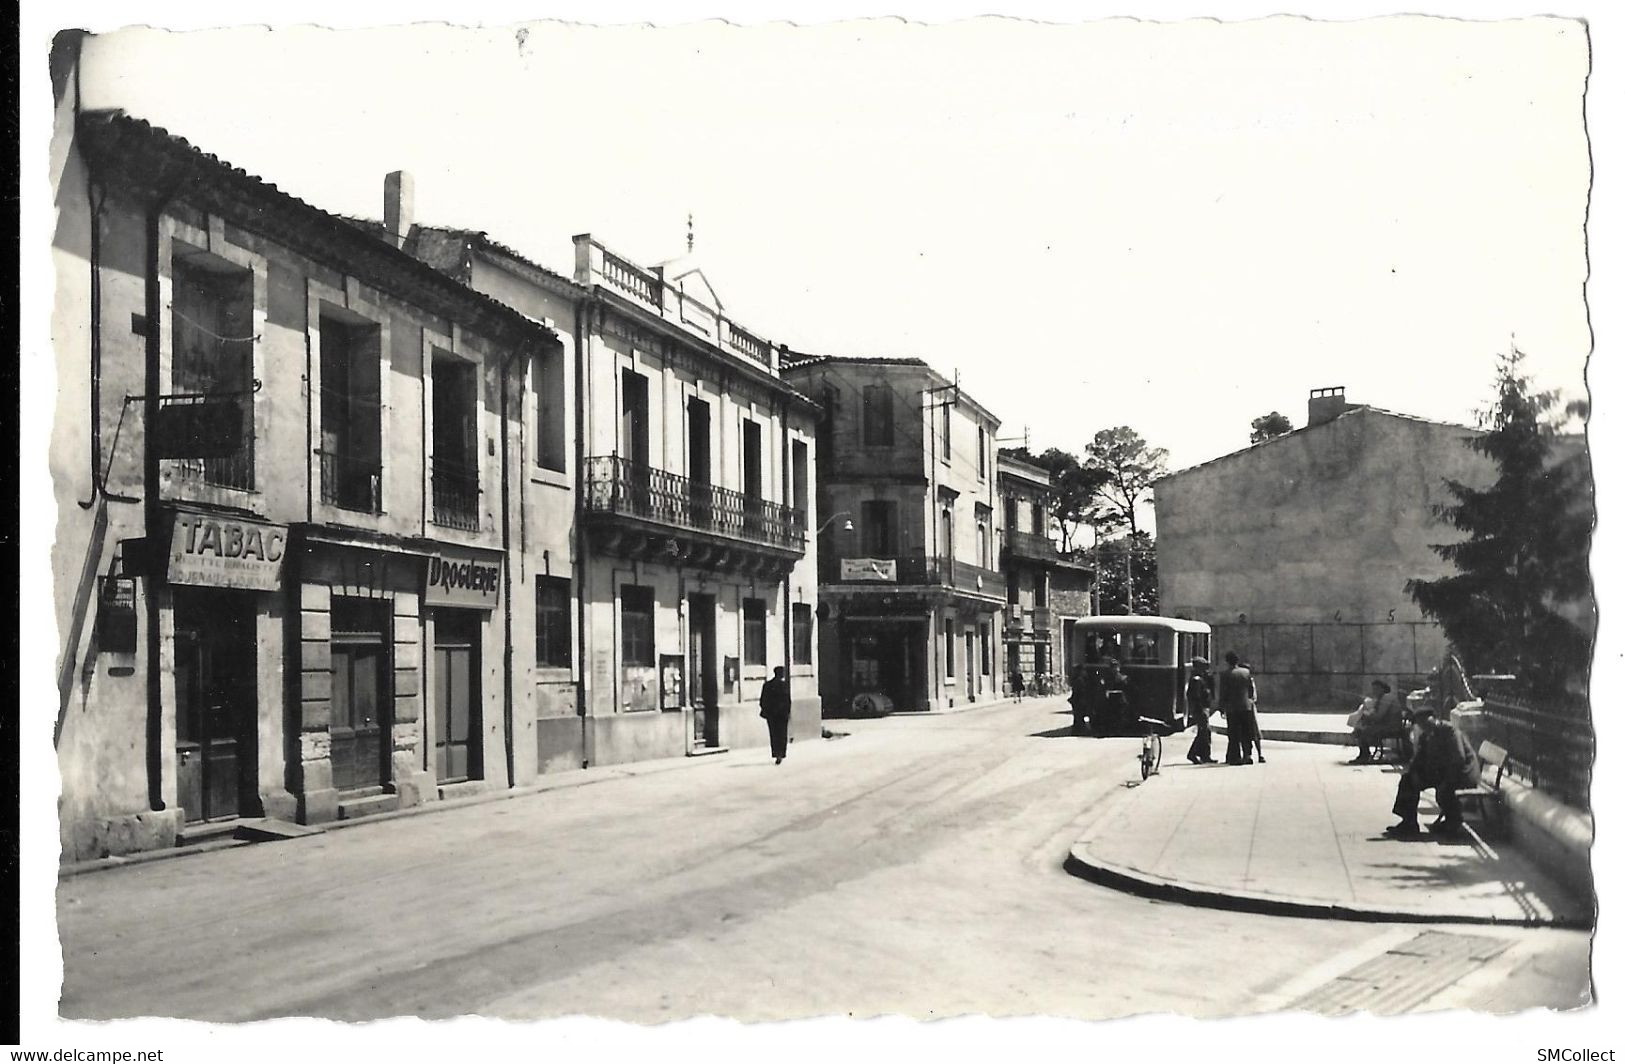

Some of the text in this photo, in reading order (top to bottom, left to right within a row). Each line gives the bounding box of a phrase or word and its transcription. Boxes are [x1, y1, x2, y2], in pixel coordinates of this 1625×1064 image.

[182, 515, 283, 562] TABAC
[429, 557, 498, 597] DROGUERIE
[1387, 607, 1397, 622] 5
